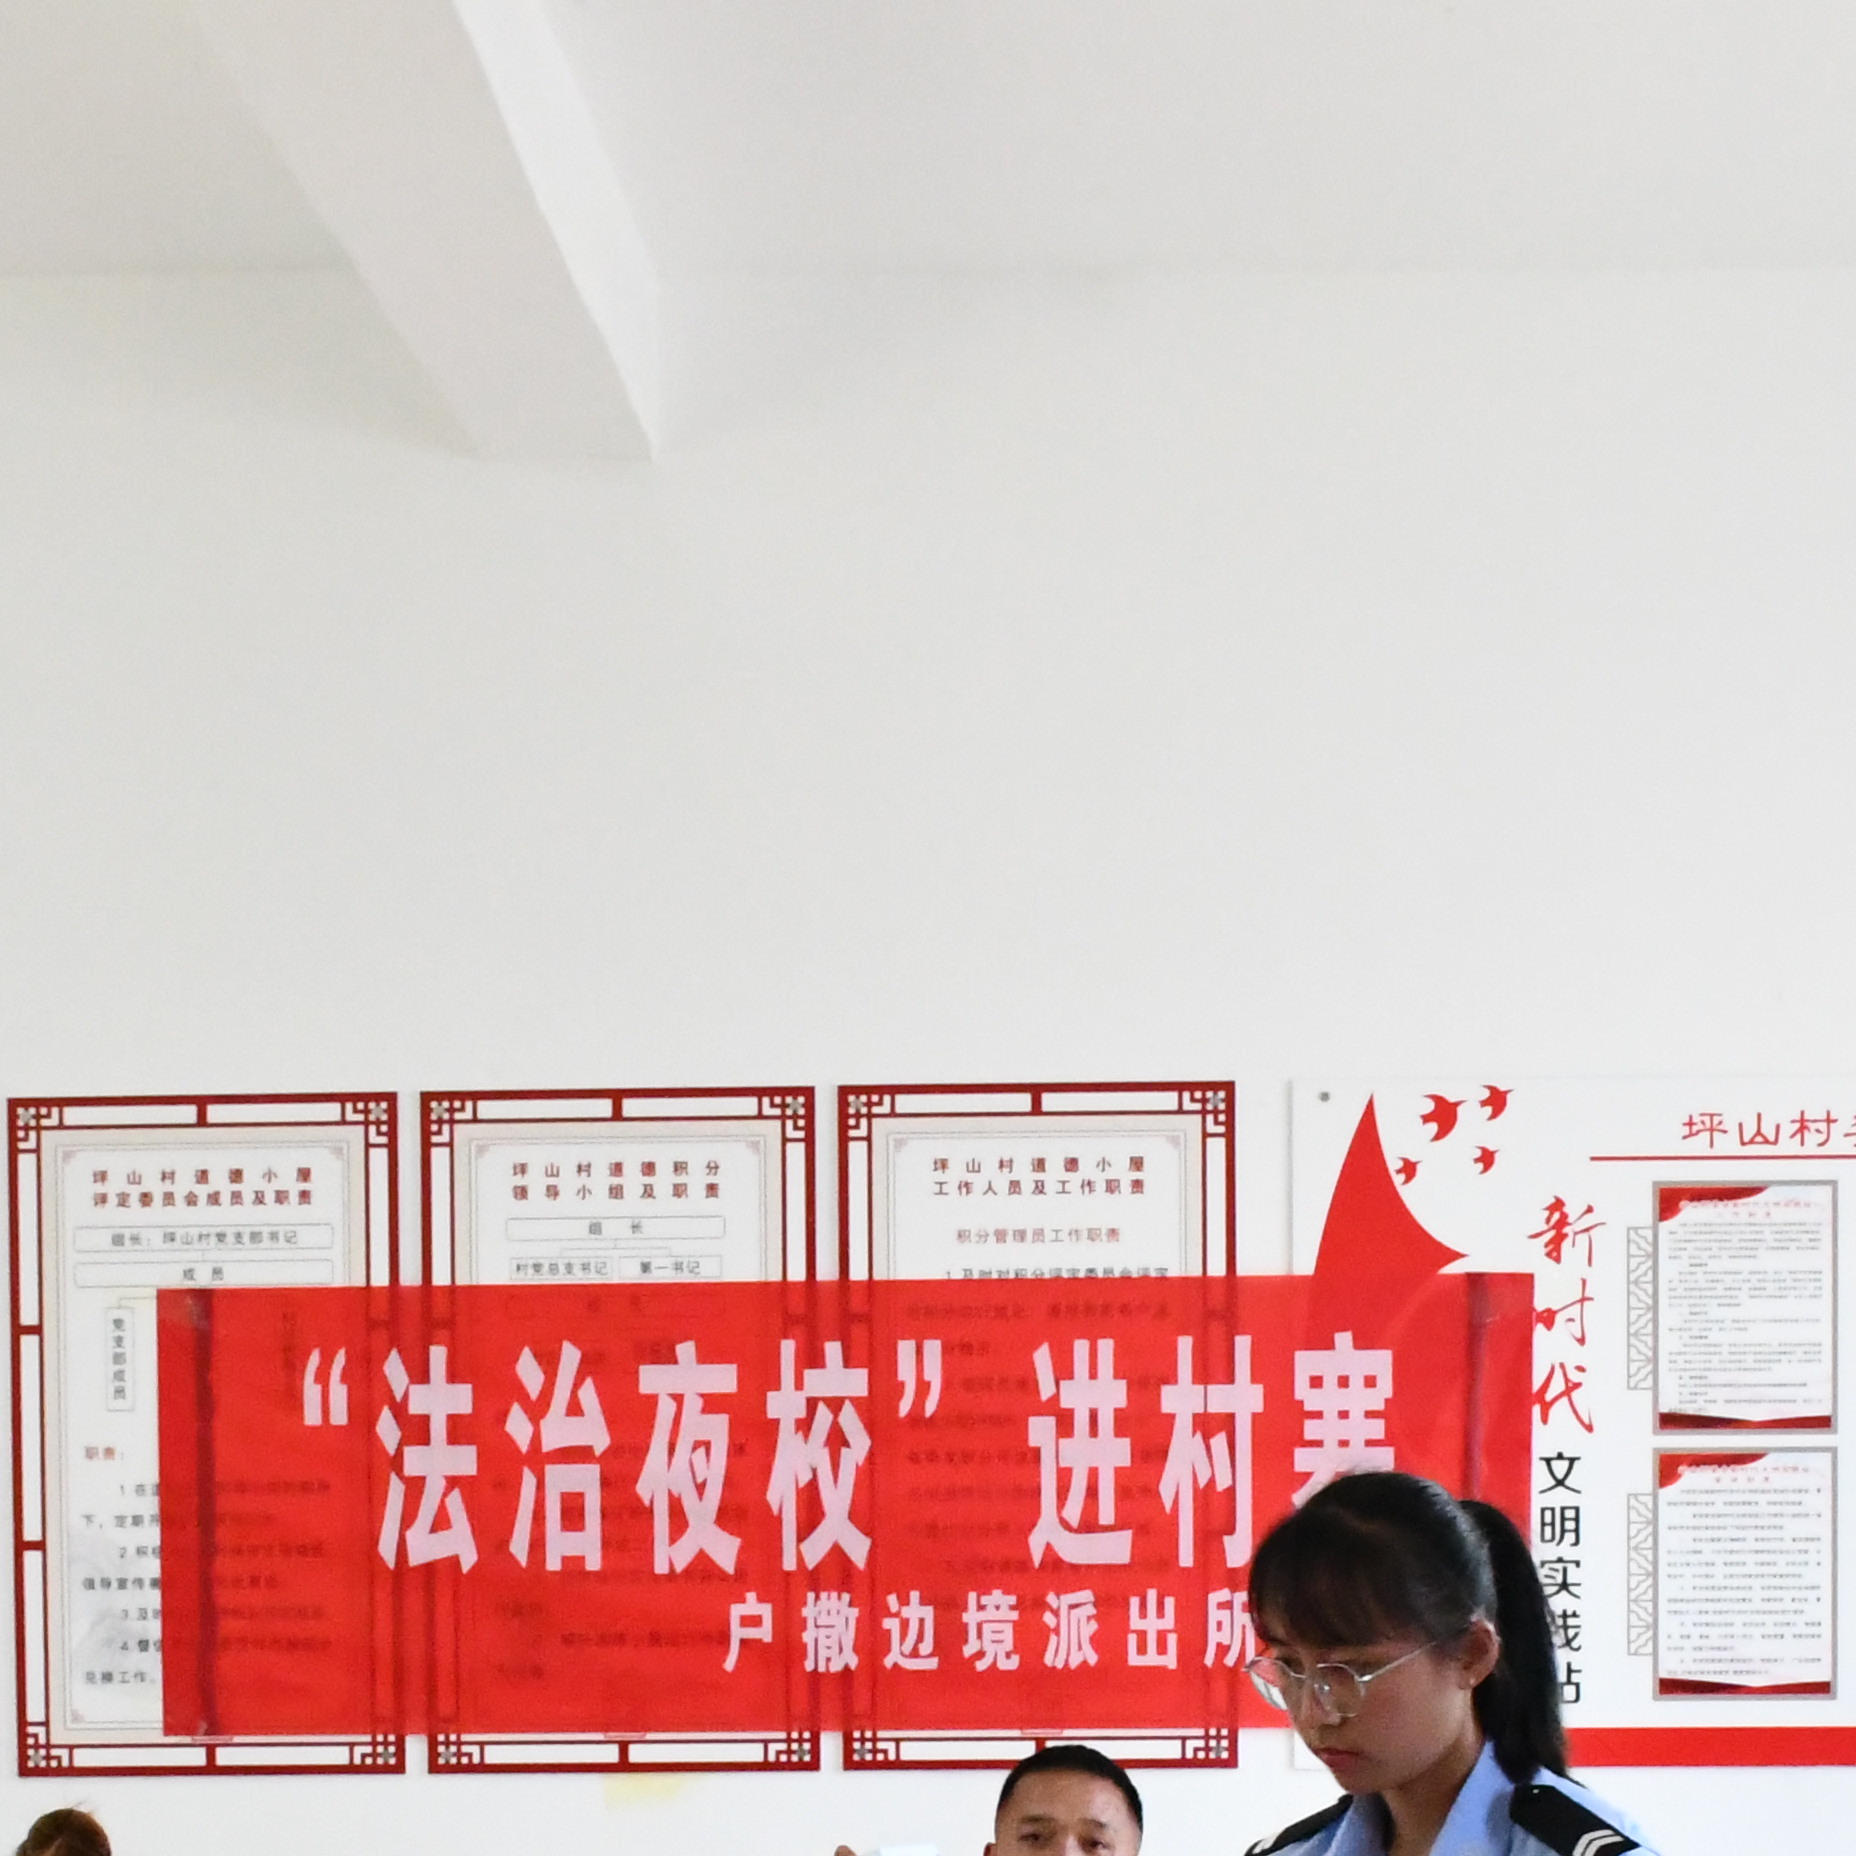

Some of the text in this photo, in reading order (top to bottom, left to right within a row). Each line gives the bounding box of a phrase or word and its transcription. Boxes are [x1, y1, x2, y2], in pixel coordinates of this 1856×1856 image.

[512, 1161, 721, 1179] 坪山村道德积分
[933, 1156, 1145, 1174] 坪山村道德小屋
[93, 1167, 312, 1185] 坪山村道德小屋
[512, 1183, 721, 1200] 领导小组及职责
[933, 1179, 1145, 1196] 工作人员及工作职责
[93, 1190, 313, 1208] 评定委员会成员及职责
[1527, 1196, 1606, 1434] 新时代
